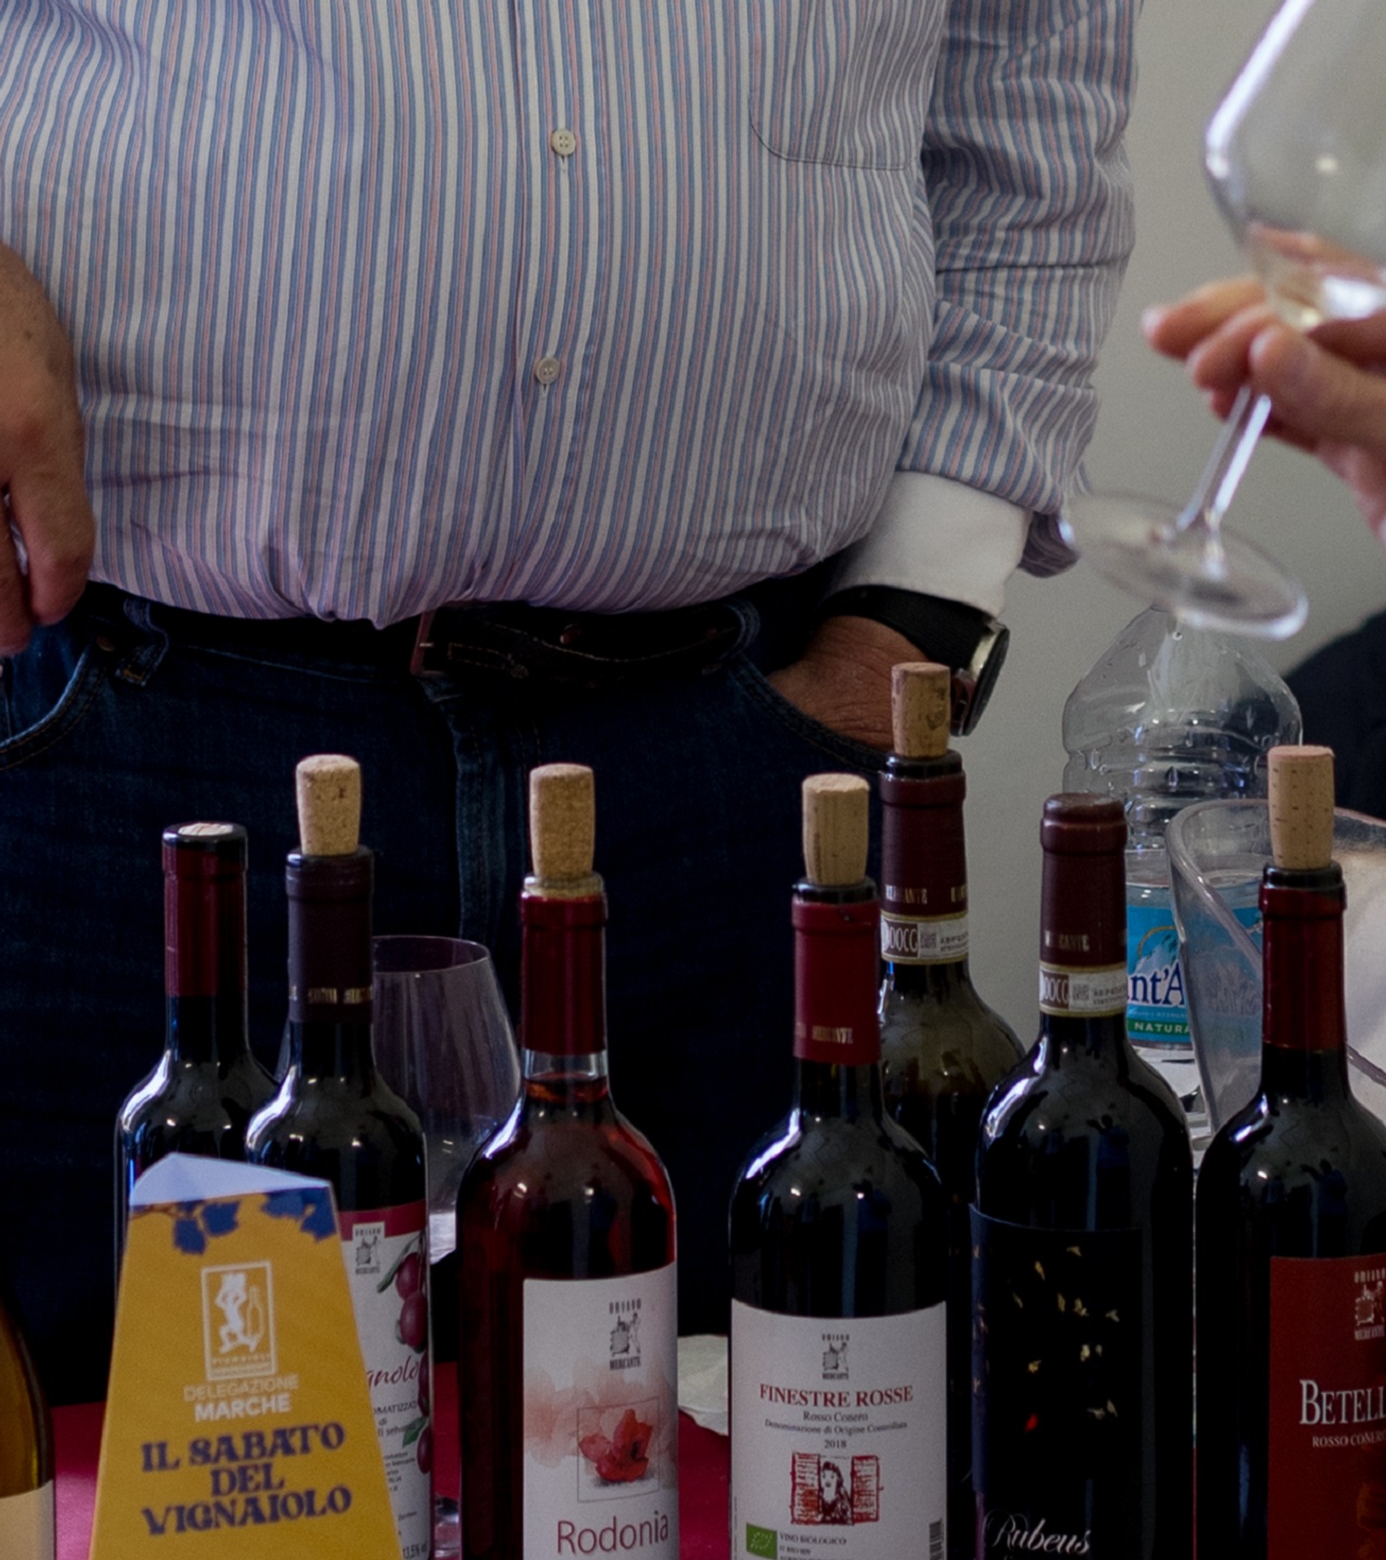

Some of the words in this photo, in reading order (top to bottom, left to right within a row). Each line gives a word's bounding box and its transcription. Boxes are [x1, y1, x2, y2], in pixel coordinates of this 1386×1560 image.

[1128, 961, 1186, 1006] nt'A
[183, 1372, 300, 1403] DELEGAZIONE
[759, 1383, 851, 1408] FINESTRE
[856, 1384, 914, 1408] ROSSE
[195, 1392, 292, 1423] MARCHE
[803, 1410, 832, 1422] Rosso
[833, 1410, 869, 1423] Conero
[142, 1441, 181, 1472] IL
[188, 1421, 346, 1466] SABATO
[823, 1439, 848, 1450] 2018
[1312, 1434, 1349, 1449] ROSSO
[210, 1461, 286, 1498] DEL
[141, 1484, 353, 1537] VIGNAIOLO
[556, 1509, 669, 1555] Rodonia
